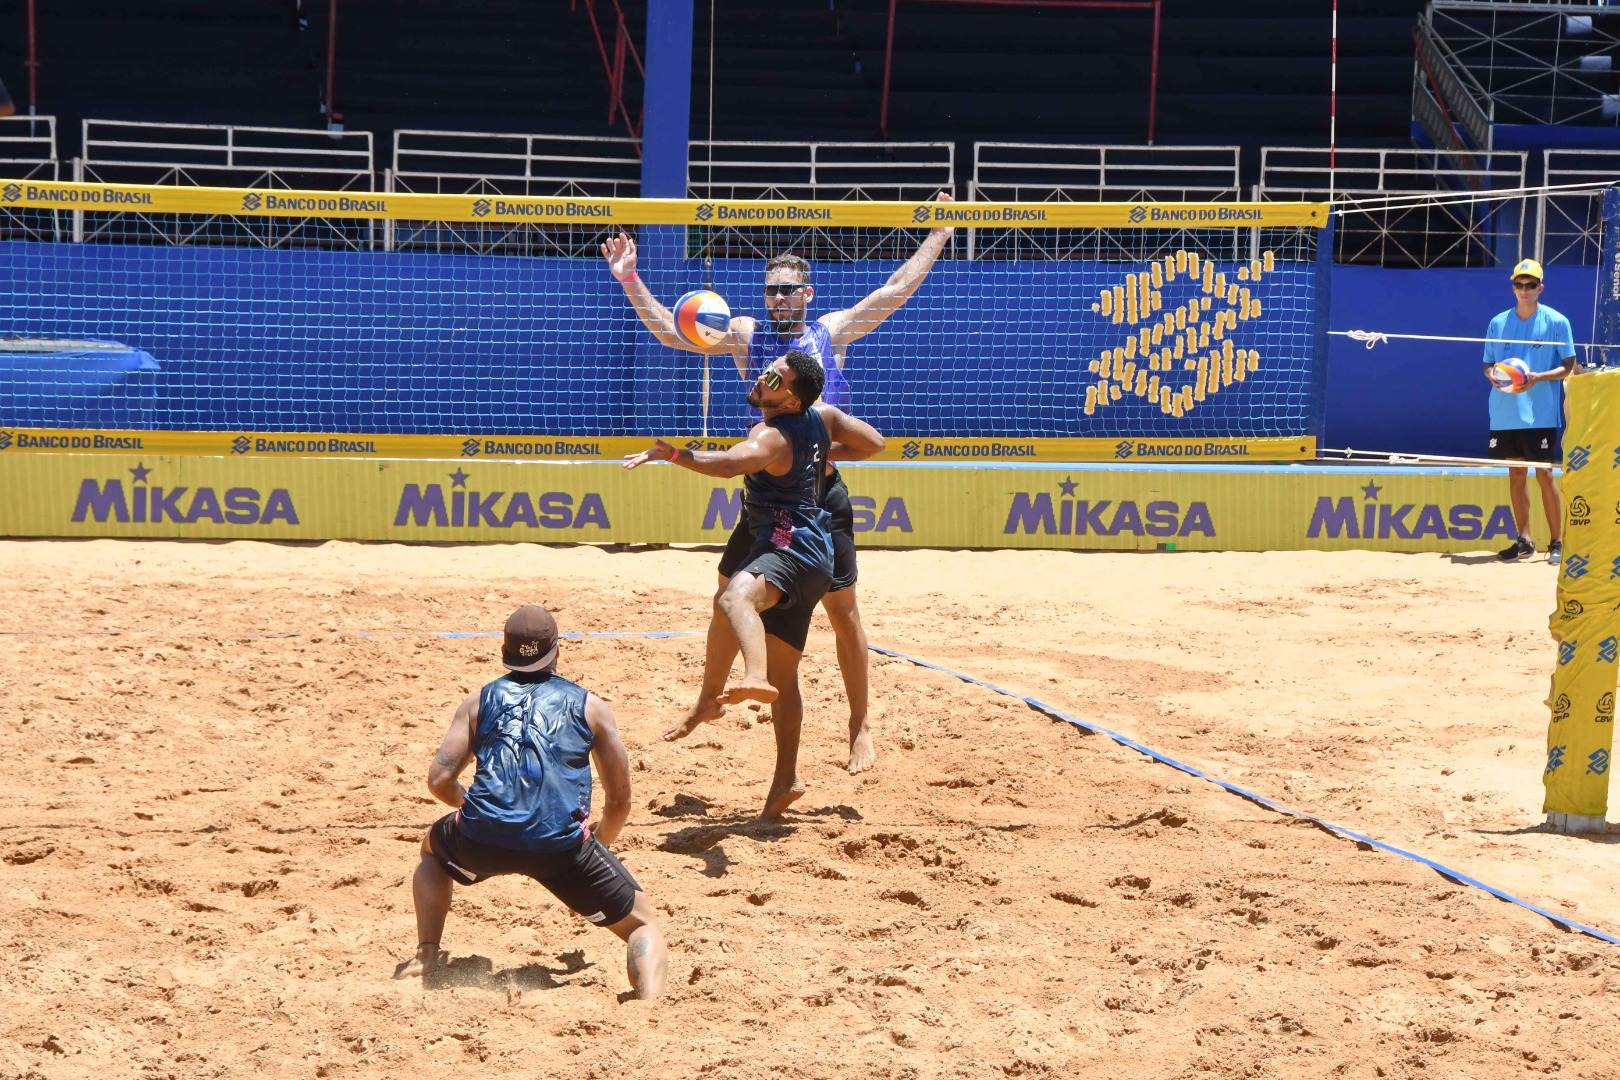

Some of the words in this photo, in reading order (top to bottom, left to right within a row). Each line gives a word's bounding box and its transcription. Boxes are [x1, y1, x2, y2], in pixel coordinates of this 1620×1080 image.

[27, 188, 79, 201] BANCO
[81, 192, 101, 202] DO
[103, 190, 152, 204] BRASIL
[266, 196, 317, 210] BANCO
[318, 199, 338, 210] DO
[339, 198, 386, 212] BRASIL
[495, 202, 545, 215] BANCO
[545, 206, 565, 215] DO
[566, 203, 612, 217] BRASIL
[717, 207, 765, 219] BANCO
[767, 210, 785, 219] DO
[787, 207, 832, 220] BRASIL
[934, 208, 981, 220] BANCO
[983, 211, 1001, 220] DO
[1002, 208, 1047, 221] BRASIL
[1151, 209, 1197, 220] BANCO
[1199, 211, 1217, 220] DO
[1218, 208, 1264, 221] BRASIL
[17, 435, 69, 449] BANCO
[71, 437, 91, 449] DO
[93, 437, 144, 451] BRASIL
[255, 439, 305, 453] BANCO
[307, 441, 327, 453] DO
[328, 439, 376, 454] BRASIL
[484, 440, 533, 455] BANCO
[534, 443, 553, 455] DO
[554, 441, 600, 456] BRASIL
[923, 444, 971, 457] BANCO
[971, 446, 990, 457] DO
[991, 444, 1036, 458] BRASIL
[1138, 444, 1183, 457] BANCO
[1185, 446, 1203, 457] DO
[1203, 444, 1250, 457] BRASIL
[813, 443, 820, 462] 2
[72, 479, 299, 523] MIKASA
[394, 484, 610, 528] MIKASA
[1004, 493, 1215, 537] MIKASA
